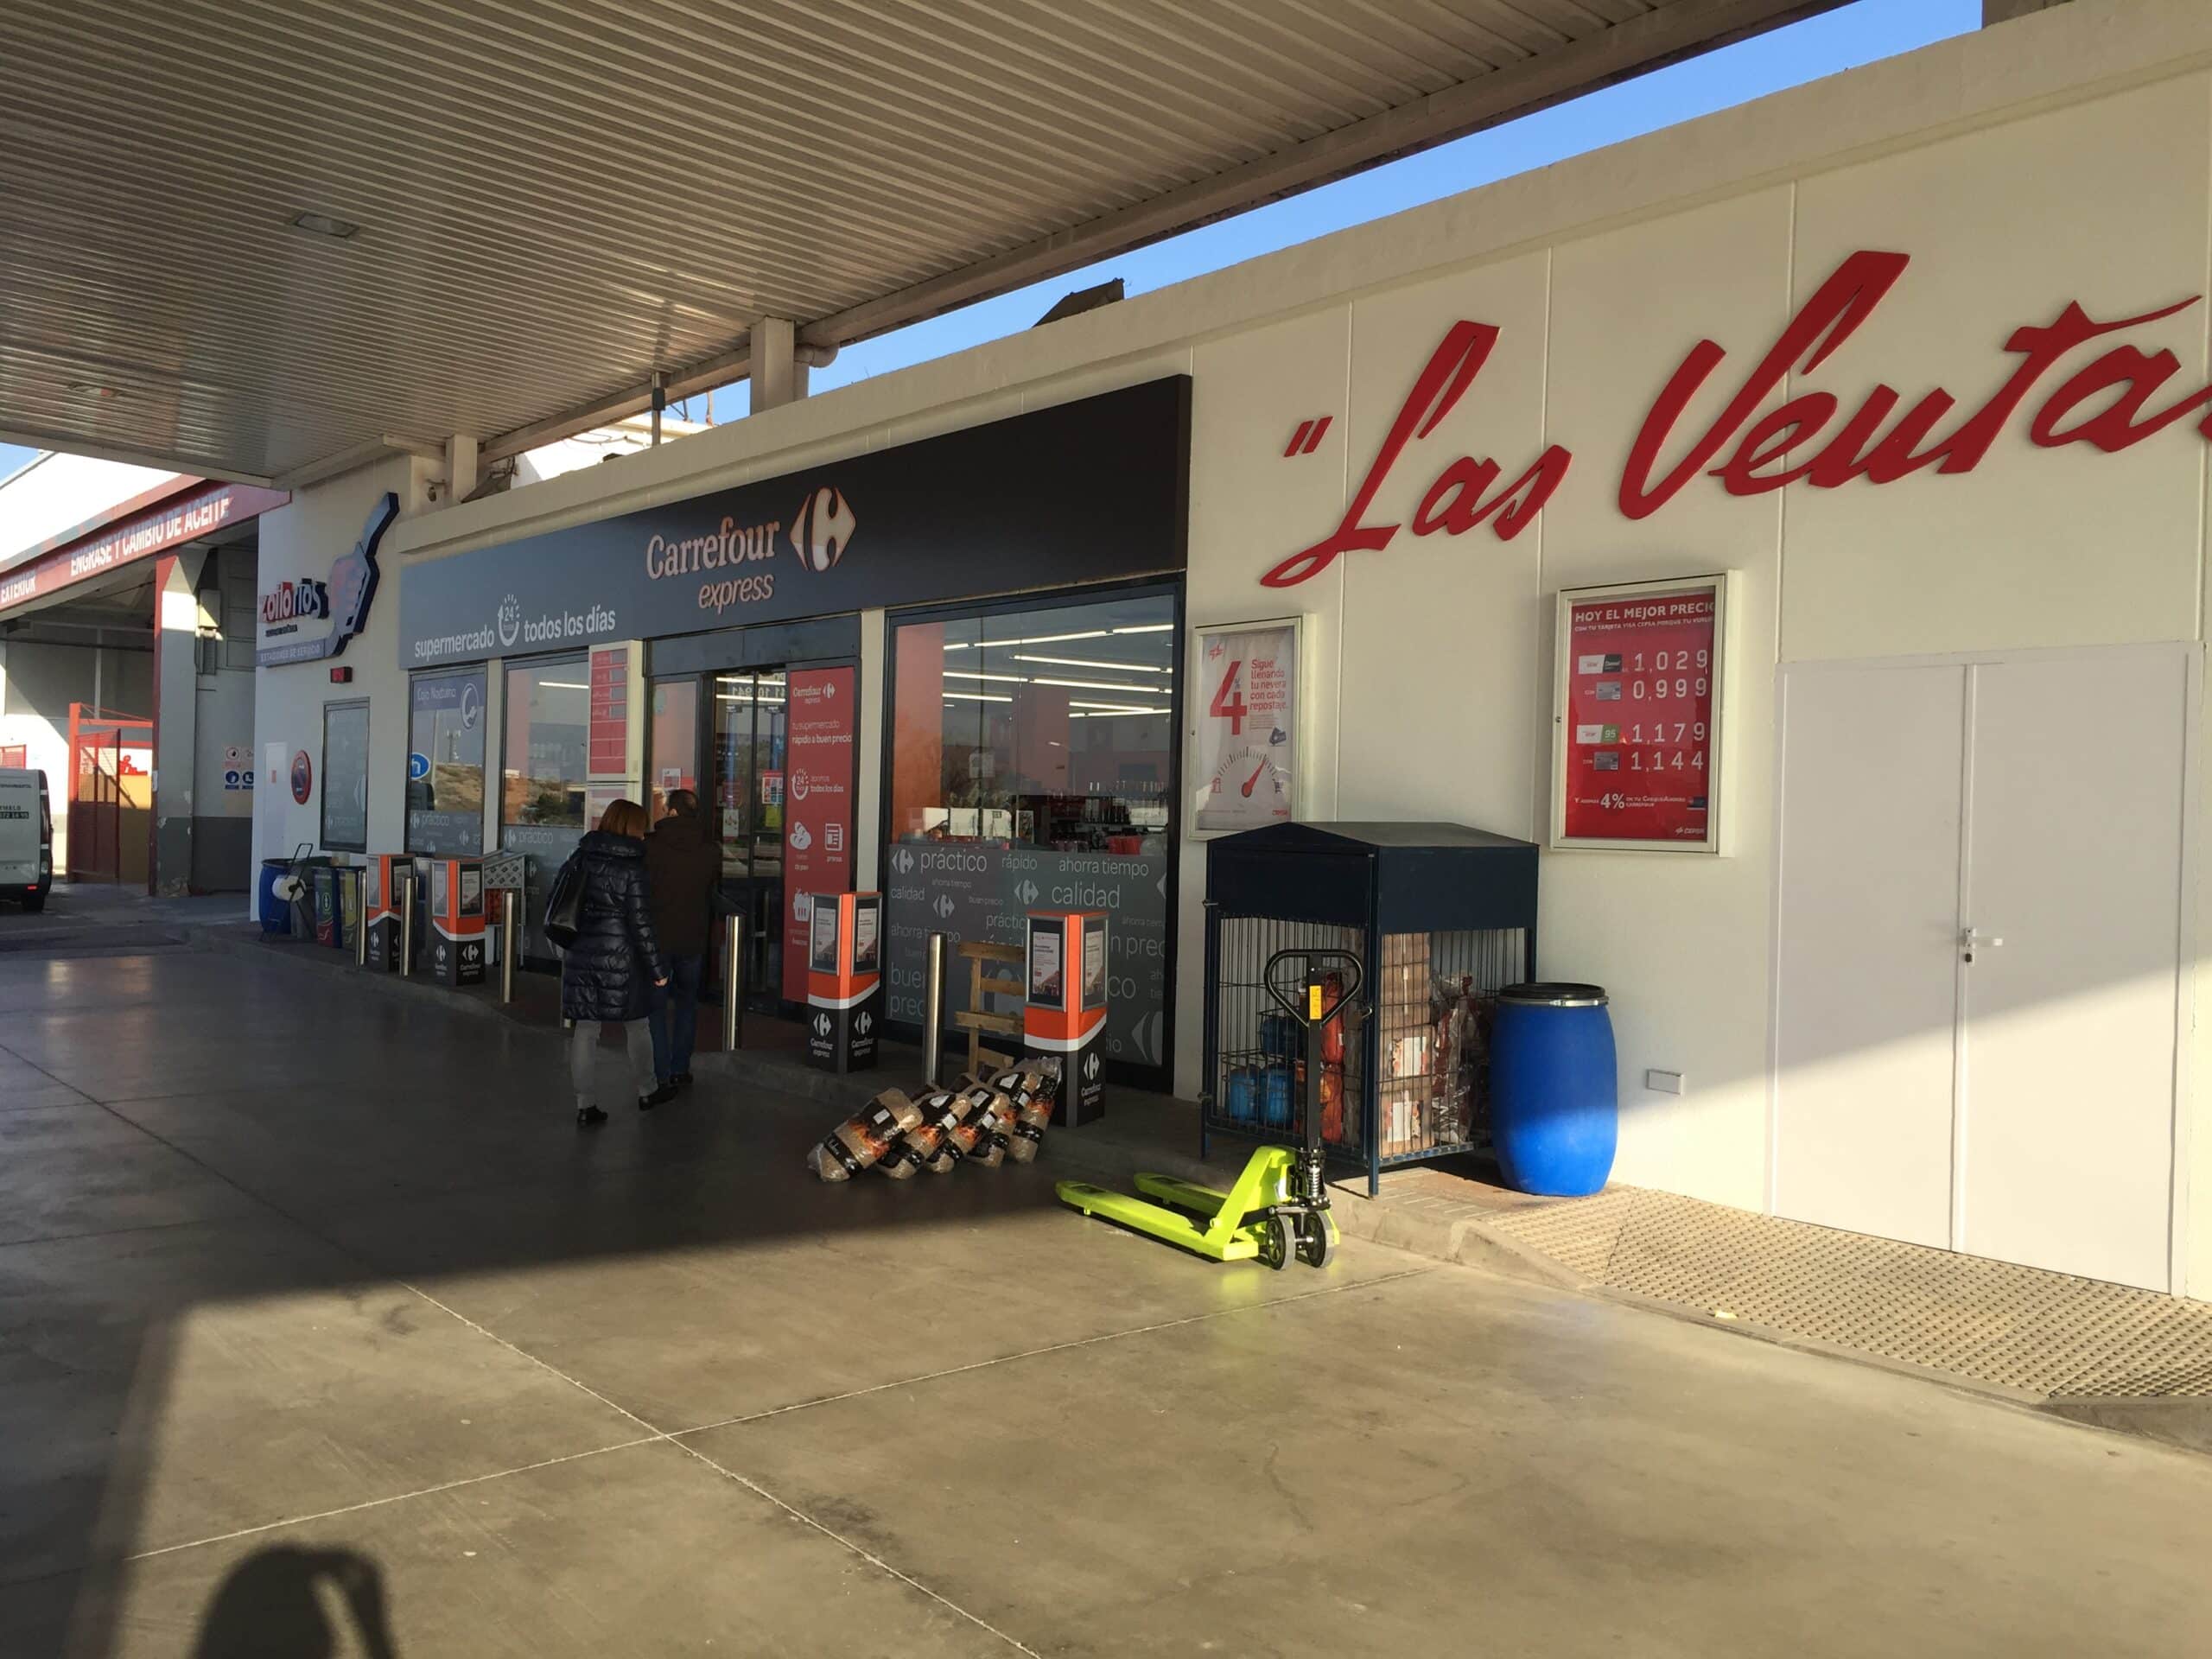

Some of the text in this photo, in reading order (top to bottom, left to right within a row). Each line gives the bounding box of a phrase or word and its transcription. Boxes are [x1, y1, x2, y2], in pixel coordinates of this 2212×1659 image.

[1618, 251, 2212, 520] Venta
[70, 489, 232, 576] ENGRASE Y CAMBIO DE ACEITE
[646, 516, 781, 581] Carrefour
[698, 574, 775, 615] express
[504, 606, 514, 622] 24
[1574, 610, 1603, 623] HOY
[1605, 609, 1620, 620] EL
[1624, 606, 1666, 620] MEJOR
[524, 604, 616, 643] todos los días
[414, 625, 495, 661] supermercado
[1250, 658, 1275, 671] Sigue
[1250, 668, 1285, 680] llenando
[792, 685, 822, 697] Carrefour
[1250, 680, 1259, 690] tu
[1260, 681, 1287, 690] nevera
[1209, 660, 1248, 736] 4
[1249, 690, 1286, 700] con cada
[1604, 728, 1617, 740] 95
[1600, 793, 1624, 809] 4%
[919, 847, 988, 874] práctico
[1001, 853, 1038, 872] rápido
[1058, 855, 1150, 880] ahorra tiempo
[890, 885, 926, 902] calidad
[1051, 880, 1121, 909] calidad
[986, 912, 1026, 931] práctic
[891, 922, 924, 940] ahorra
[1126, 936, 1166, 959] prec
[890, 994, 926, 1018] prec
[810, 1037, 834, 1051] Carrefour
[850, 1036, 874, 1049] Carrefour
[812, 1049, 830, 1058] express
[853, 1047, 871, 1058] express
[1081, 1082, 1102, 1098] Carrefour
